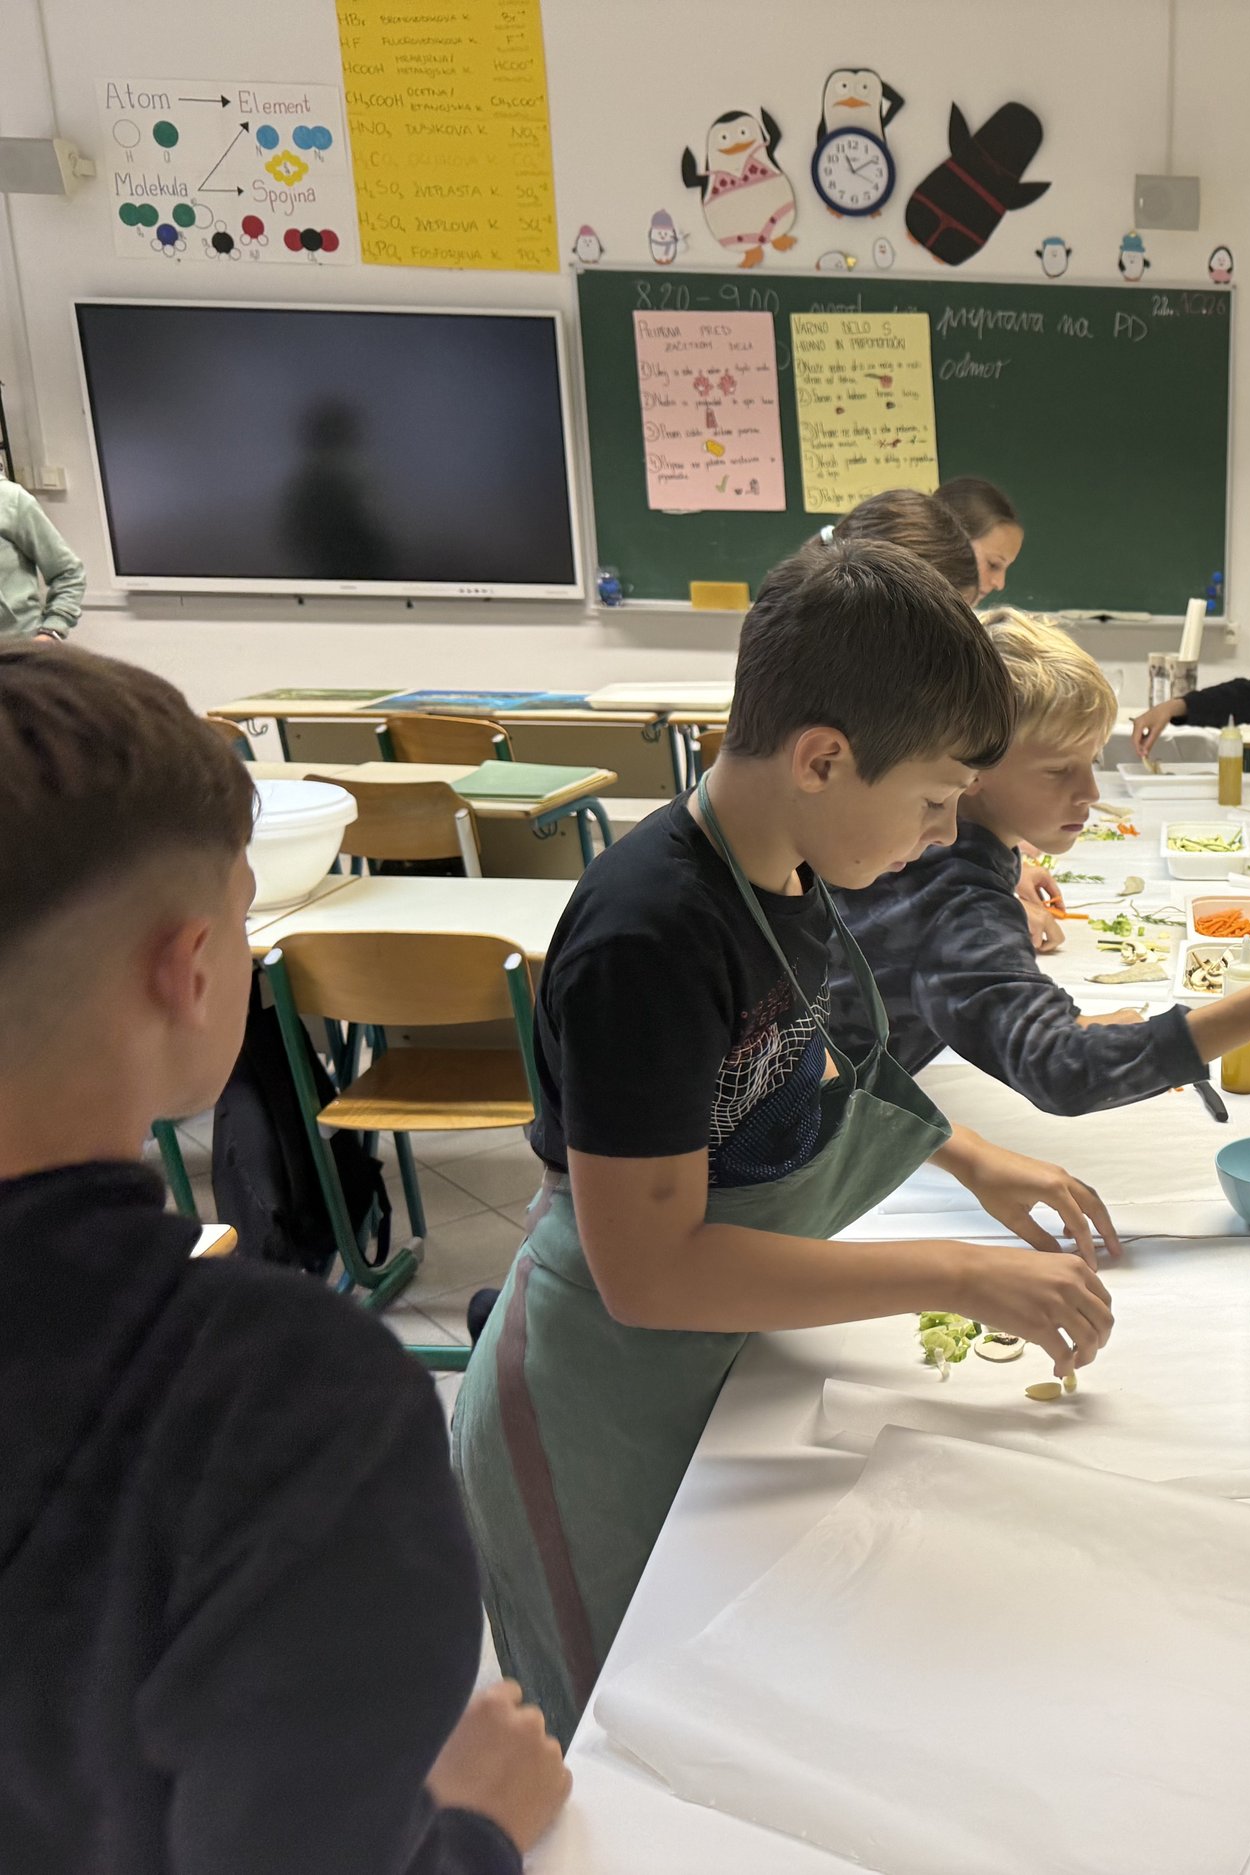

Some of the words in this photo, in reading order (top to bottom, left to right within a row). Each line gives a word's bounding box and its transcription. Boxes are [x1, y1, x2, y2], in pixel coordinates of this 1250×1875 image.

[106, 82, 171, 110] Atom
[238, 90, 310, 115] Element
[847, 140, 859, 150] 12
[115, 172, 188, 198] Molekula
[252, 179, 316, 217] Spojina
[1057, 315, 1093, 338] na
[1112, 311, 1148, 342] PD
